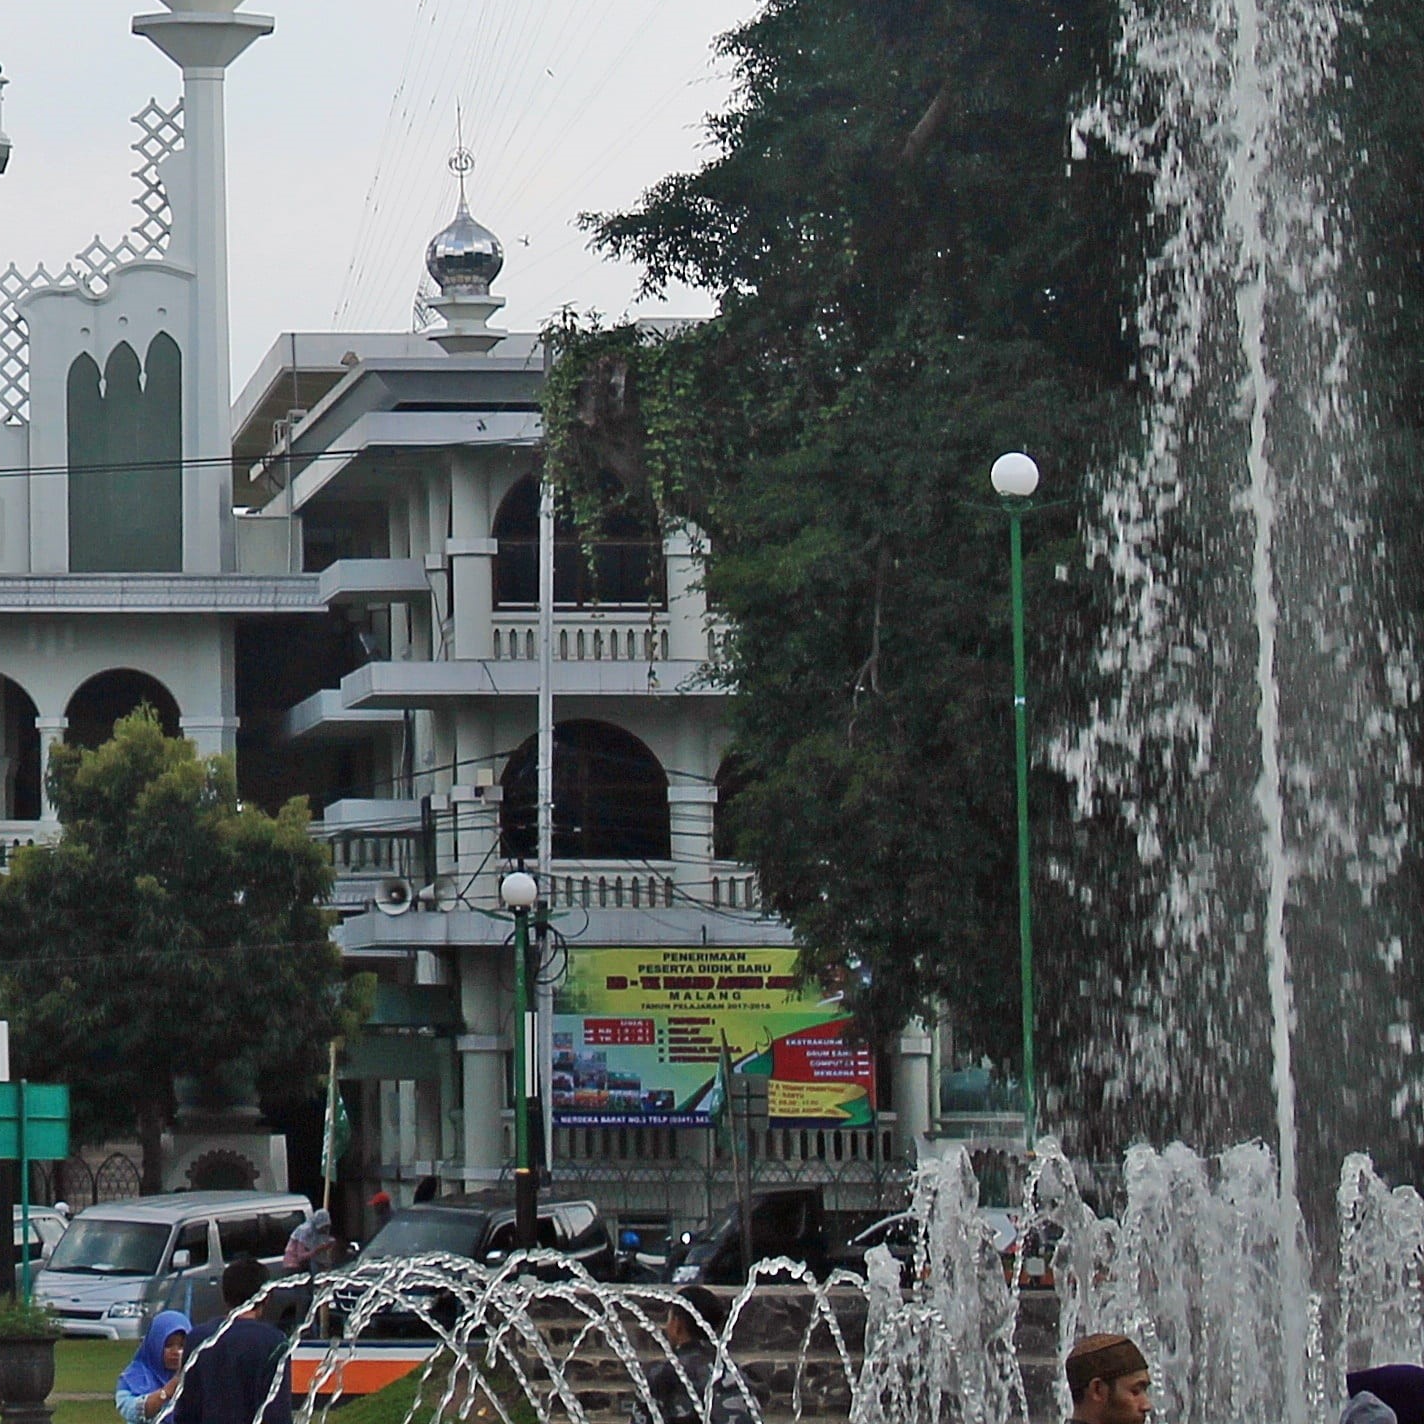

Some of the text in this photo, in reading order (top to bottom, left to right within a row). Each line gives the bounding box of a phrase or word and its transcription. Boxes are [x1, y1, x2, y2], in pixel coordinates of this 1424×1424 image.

[663, 952, 746, 962] PENERIMAAN
[638, 964, 772, 974] PESERTA DIDIK BARU
[669, 991, 742, 1001] MALANG
[560, 1116, 599, 1124] MERDEKA
[601, 1116, 626, 1124] BARAT
[649, 1116, 668, 1124] TELP
